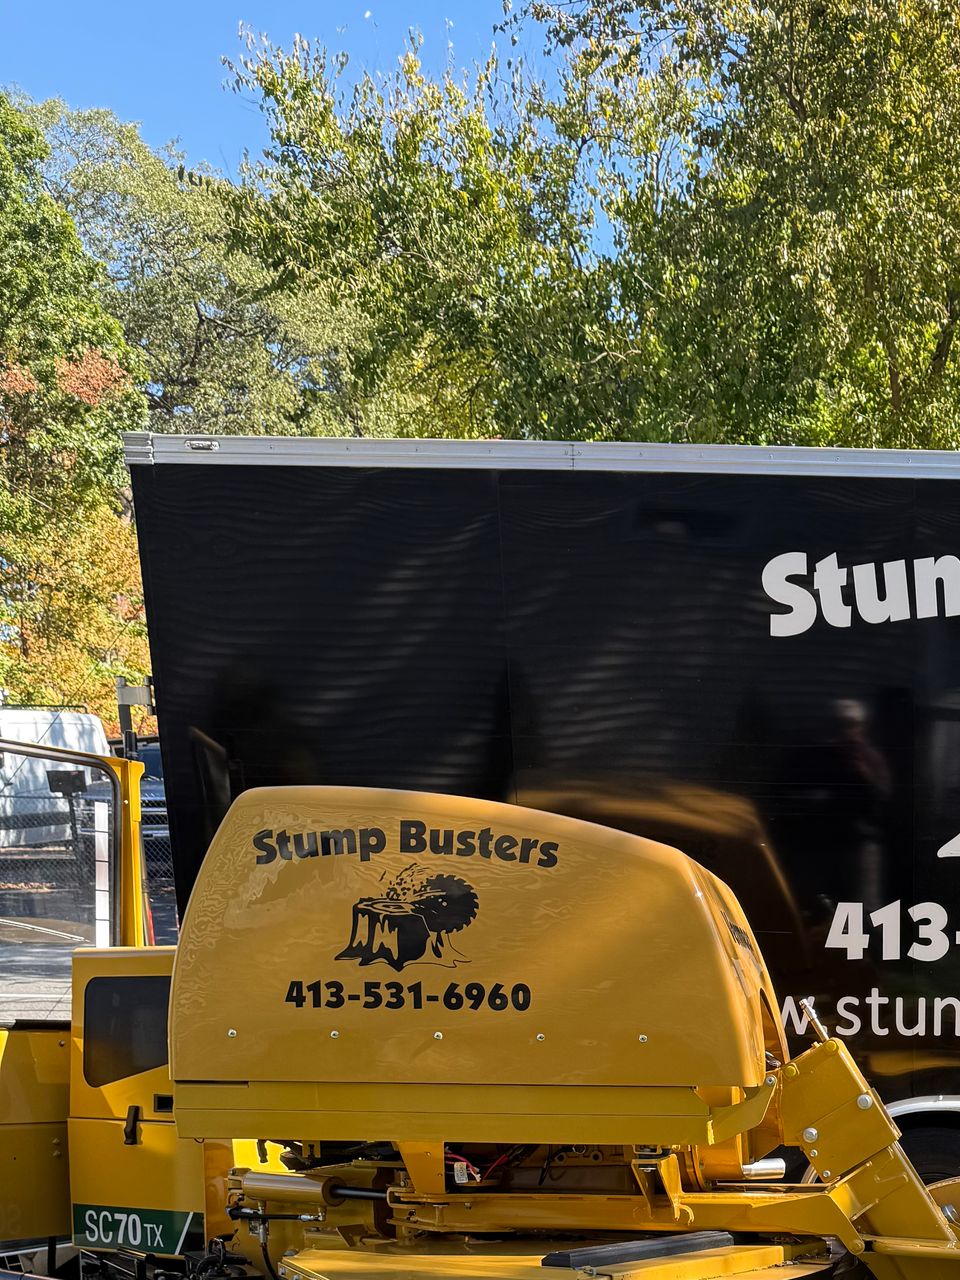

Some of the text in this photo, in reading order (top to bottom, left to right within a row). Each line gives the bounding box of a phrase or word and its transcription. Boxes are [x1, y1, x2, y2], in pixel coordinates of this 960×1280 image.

[253, 820, 560, 868] Stump Busters
[285, 980, 531, 1012] 413-531-6960
